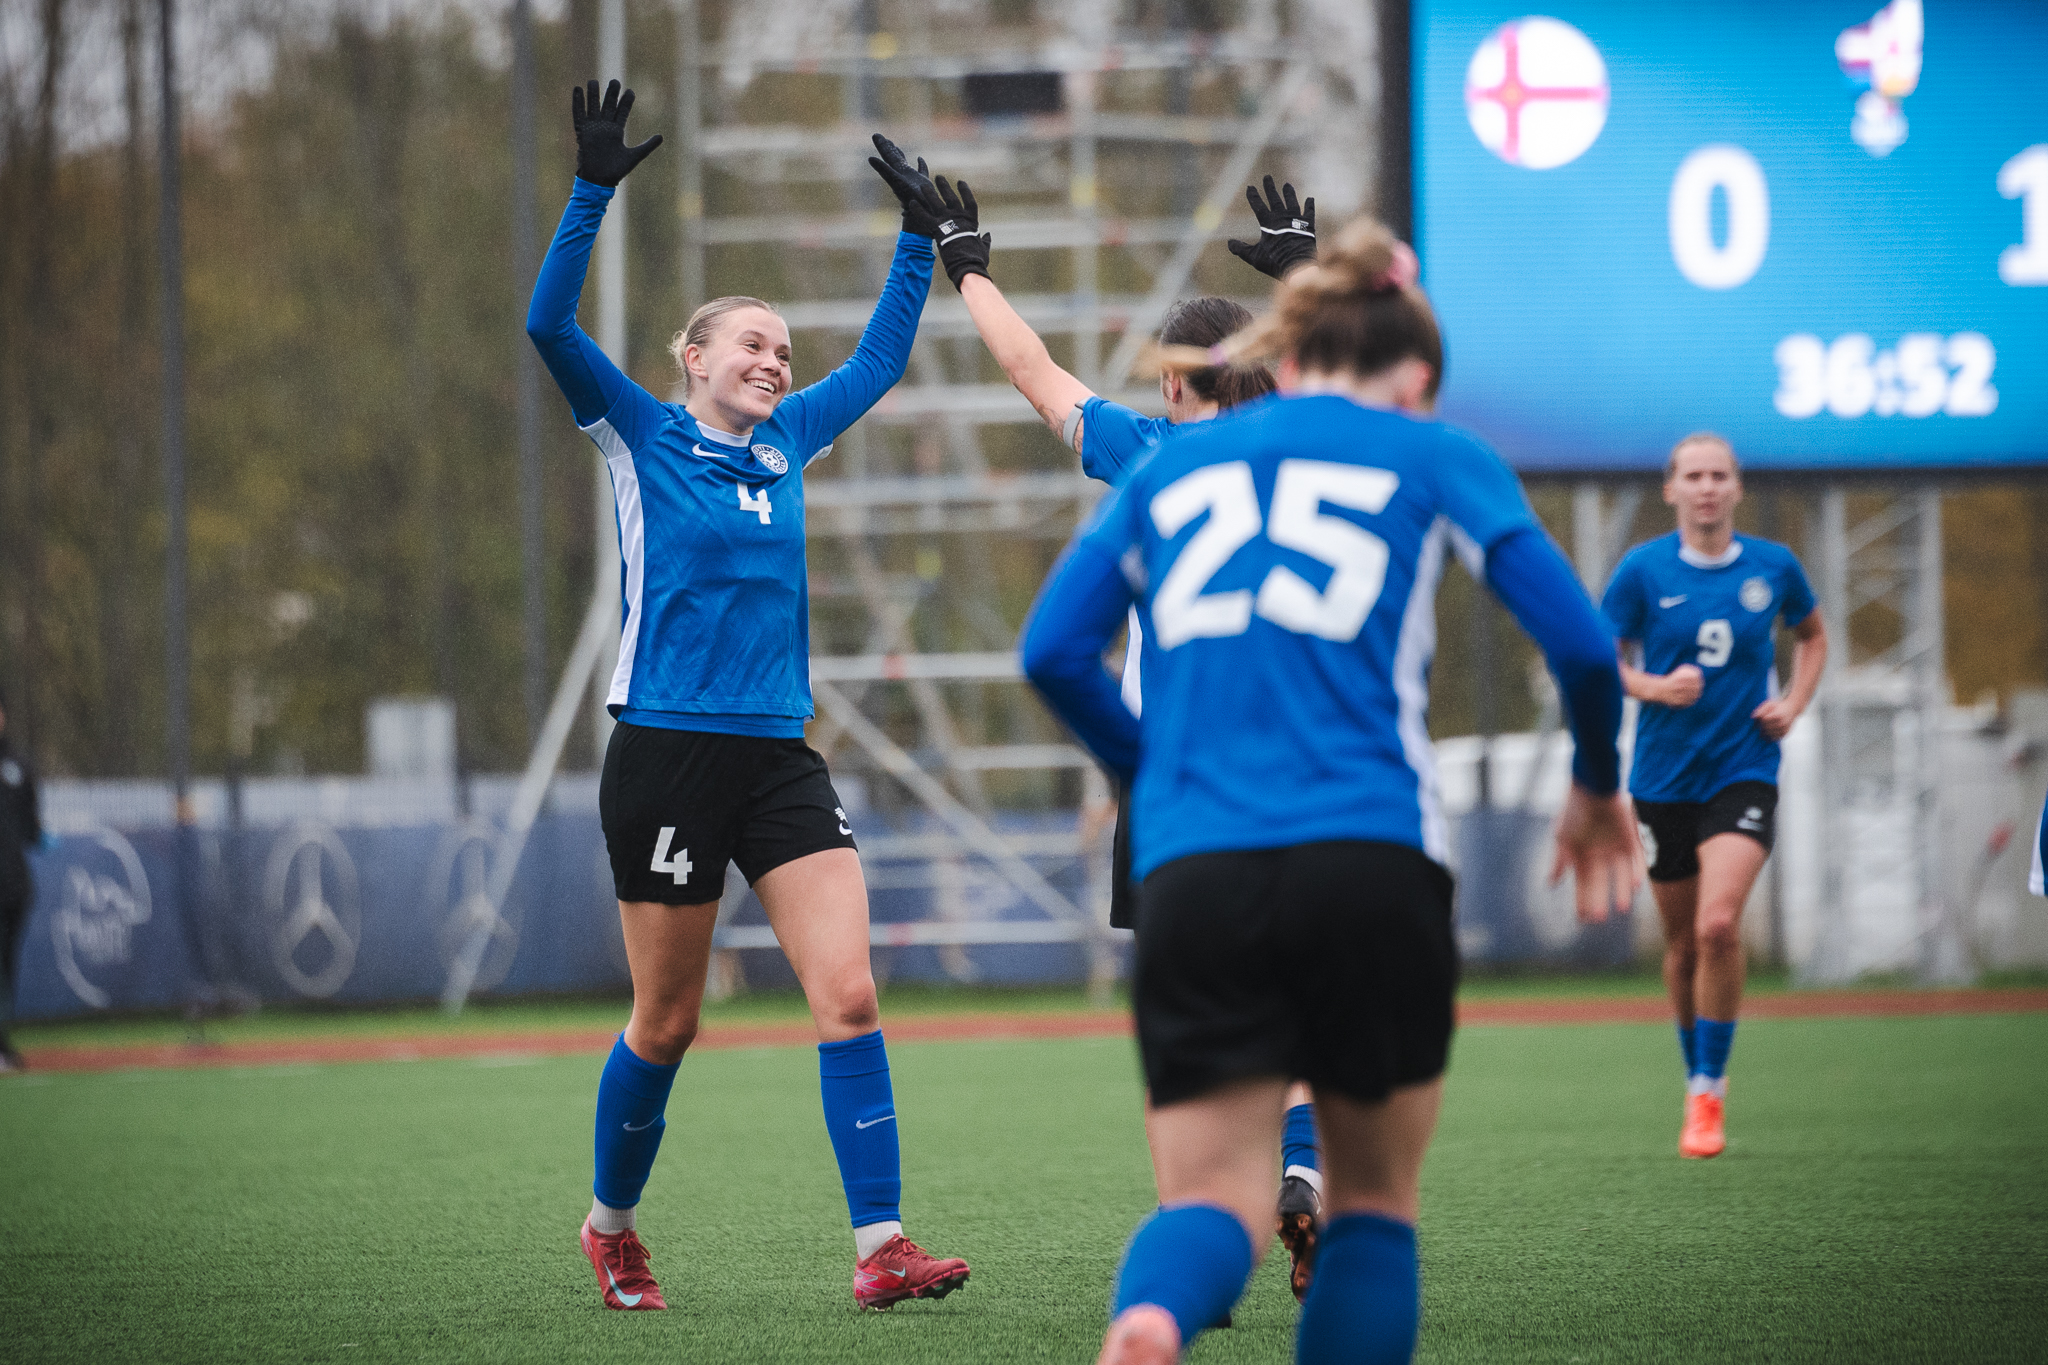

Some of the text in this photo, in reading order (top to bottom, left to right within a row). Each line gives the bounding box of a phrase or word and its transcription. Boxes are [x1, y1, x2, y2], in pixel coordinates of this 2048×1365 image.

[1667, 144, 1771, 290] 0
[1999, 145, 2048, 285] 1
[1774, 333, 1997, 418] 36:52
[737, 483, 772, 525] 4
[1151, 461, 1397, 647] 25
[1697, 620, 1733, 667] 9
[650, 826, 693, 885] 4
